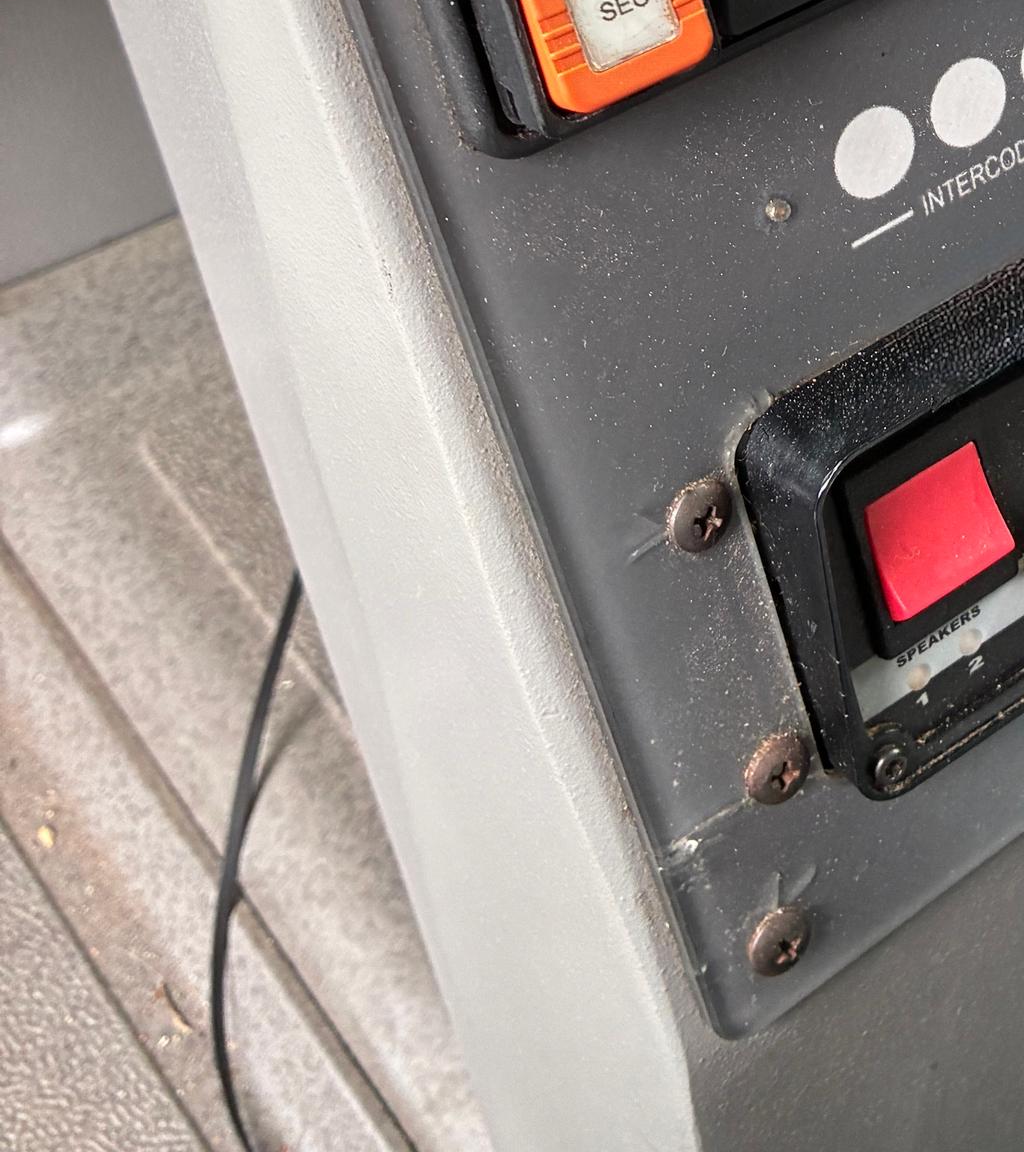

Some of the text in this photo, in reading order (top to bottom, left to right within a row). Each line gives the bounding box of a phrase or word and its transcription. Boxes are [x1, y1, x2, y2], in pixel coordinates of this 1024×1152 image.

[896, 605, 981, 668] SPEAKERS
[968, 655, 985, 675] 2
[916, 692, 930, 706] 1
